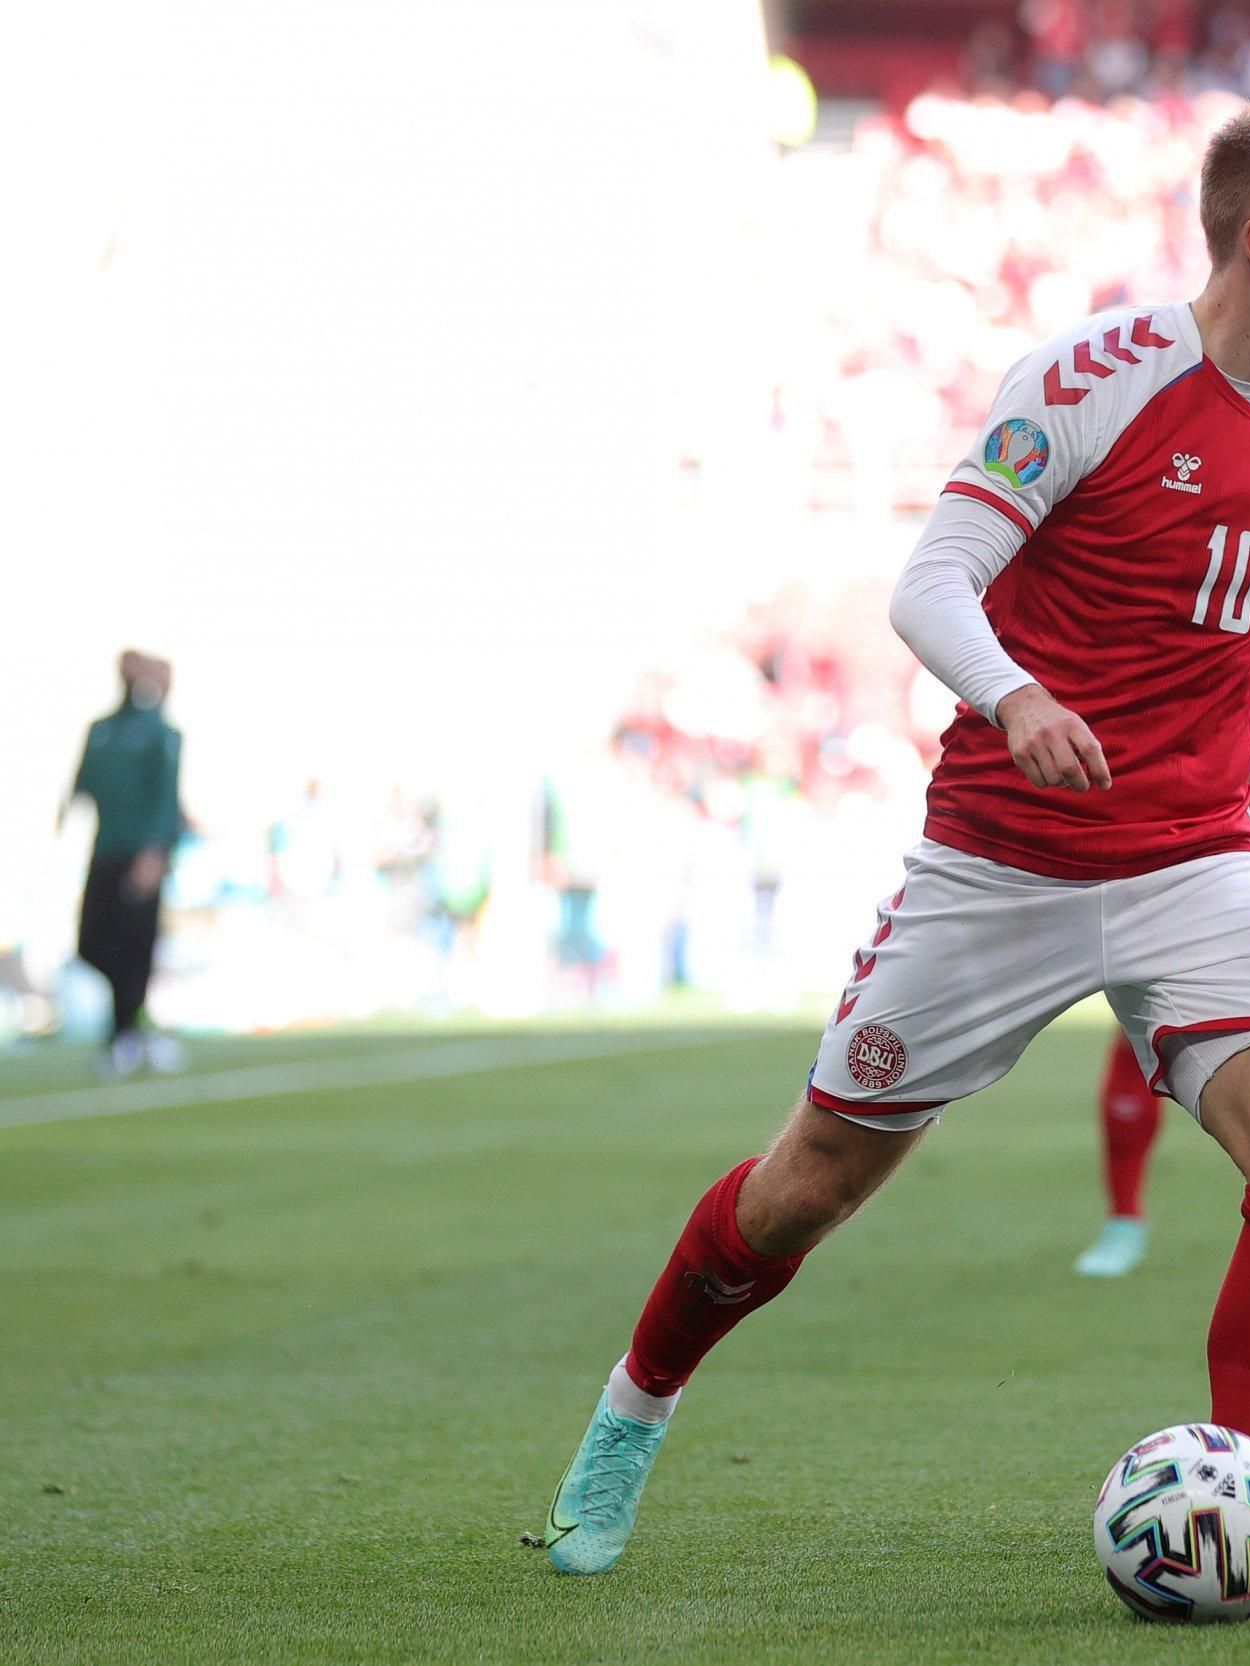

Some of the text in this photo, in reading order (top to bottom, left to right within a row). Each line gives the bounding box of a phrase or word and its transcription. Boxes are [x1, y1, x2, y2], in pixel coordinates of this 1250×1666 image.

[1161, 476, 1202, 494] hummel
[849, 1035, 861, 1073] DANSK
[887, 1054, 905, 1085] UNION
[857, 1042, 894, 1070] DBU
[857, 1075, 882, 1089] 1889
